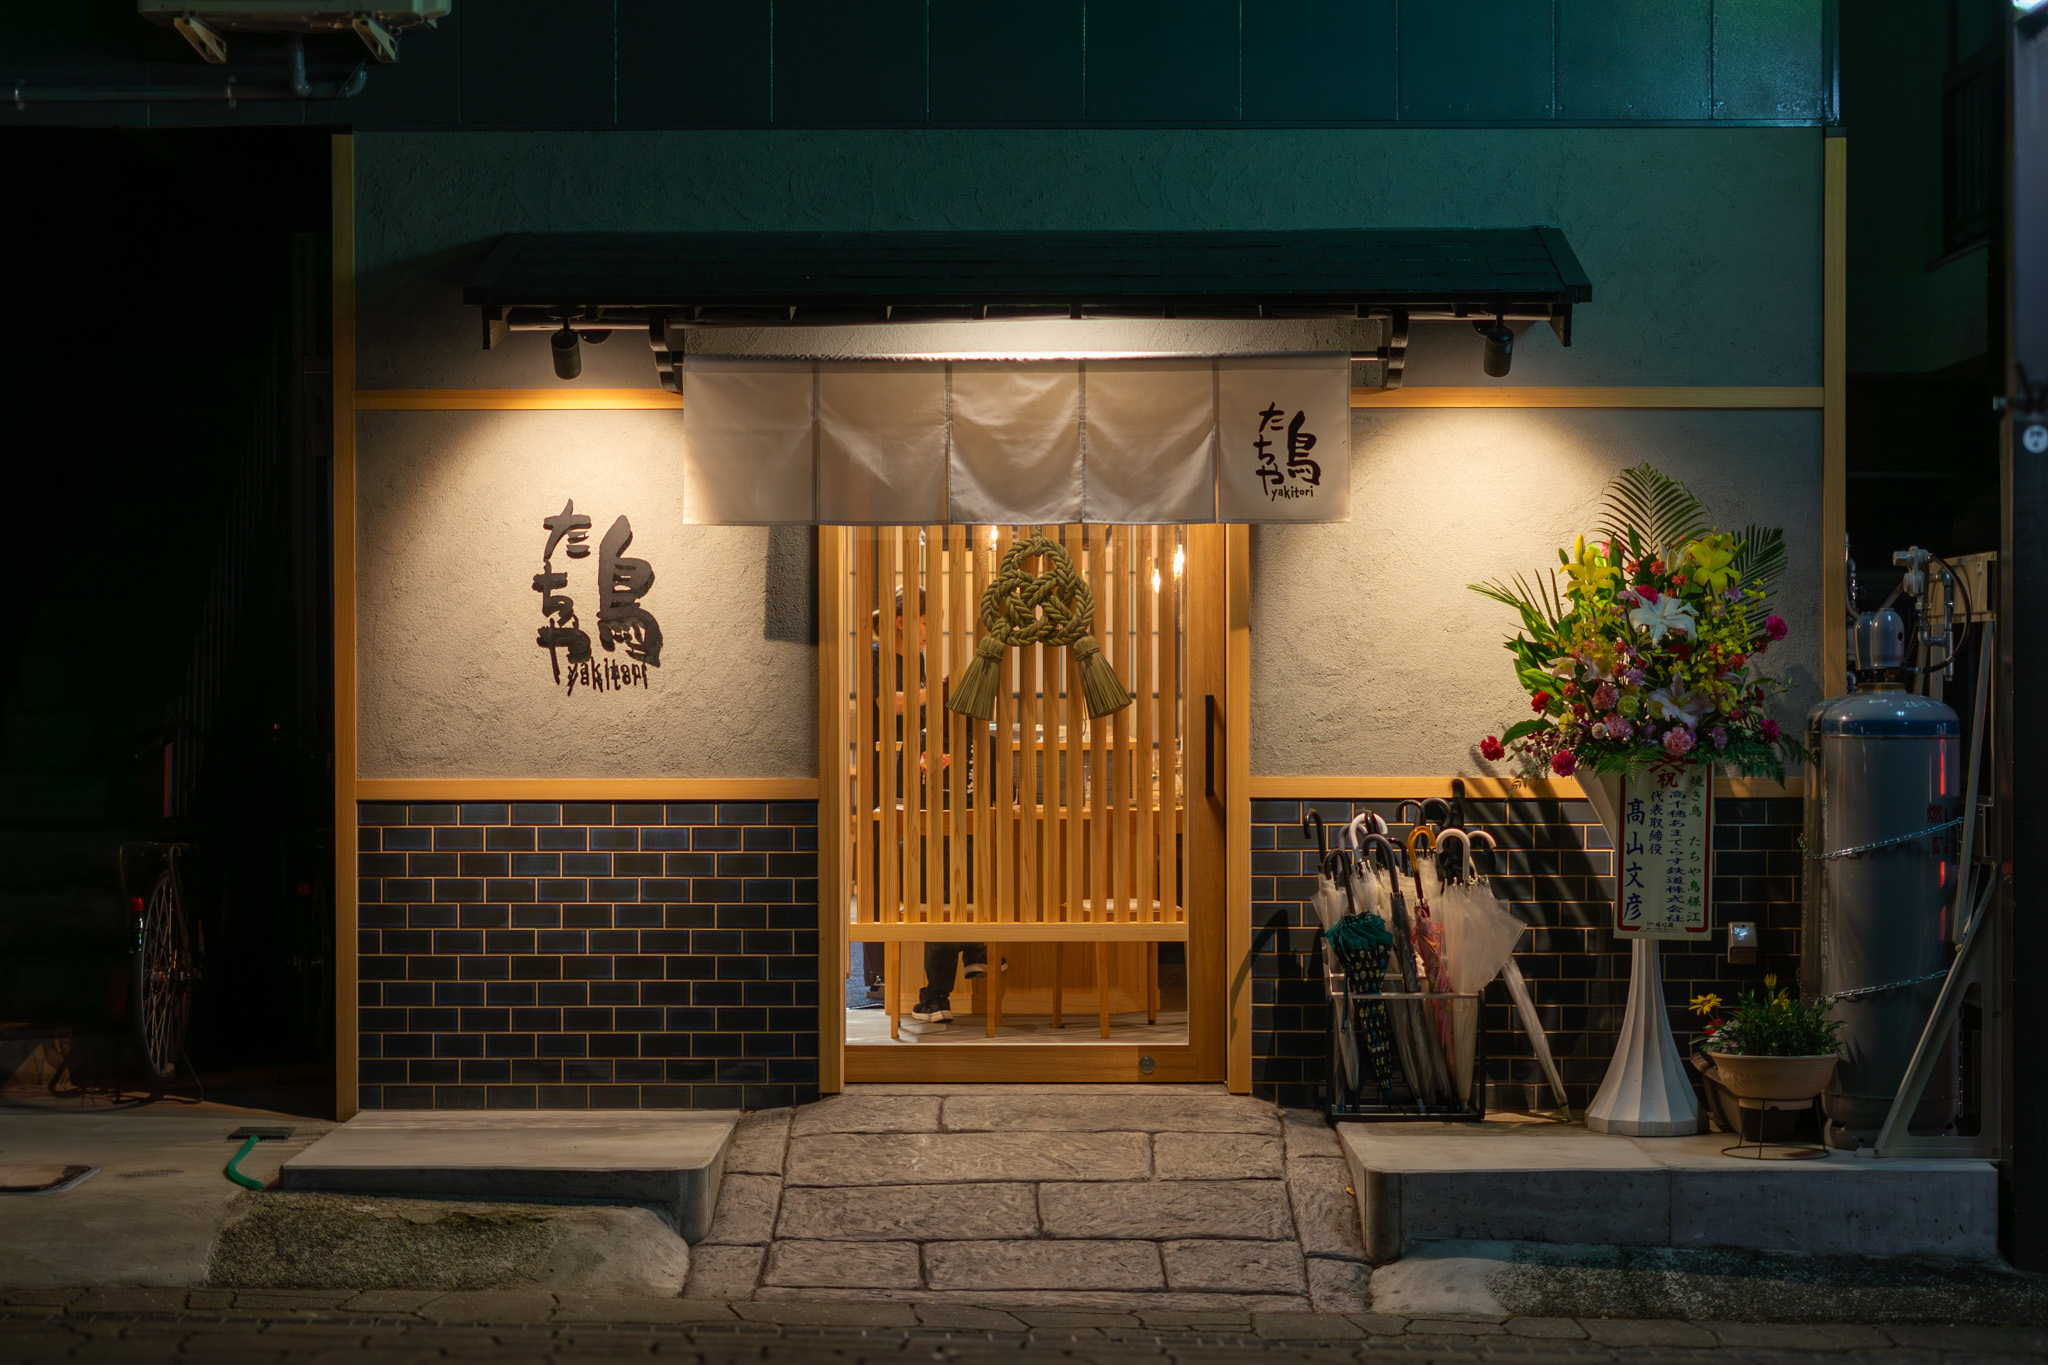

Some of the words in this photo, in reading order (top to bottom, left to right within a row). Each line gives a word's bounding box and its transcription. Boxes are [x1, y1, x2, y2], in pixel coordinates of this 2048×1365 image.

[1253, 401, 1284, 496] たちや
[1271, 485, 1314, 502] yakitori
[532, 498, 592, 685] たちや
[567, 656, 648, 696] yakitori
[1657, 769, 1679, 788] 祝
[1689, 775, 1704, 817] 焼き鳥
[1648, 791, 1664, 855] 代表取締役
[1687, 836, 1702, 922] たちや鳥様江
